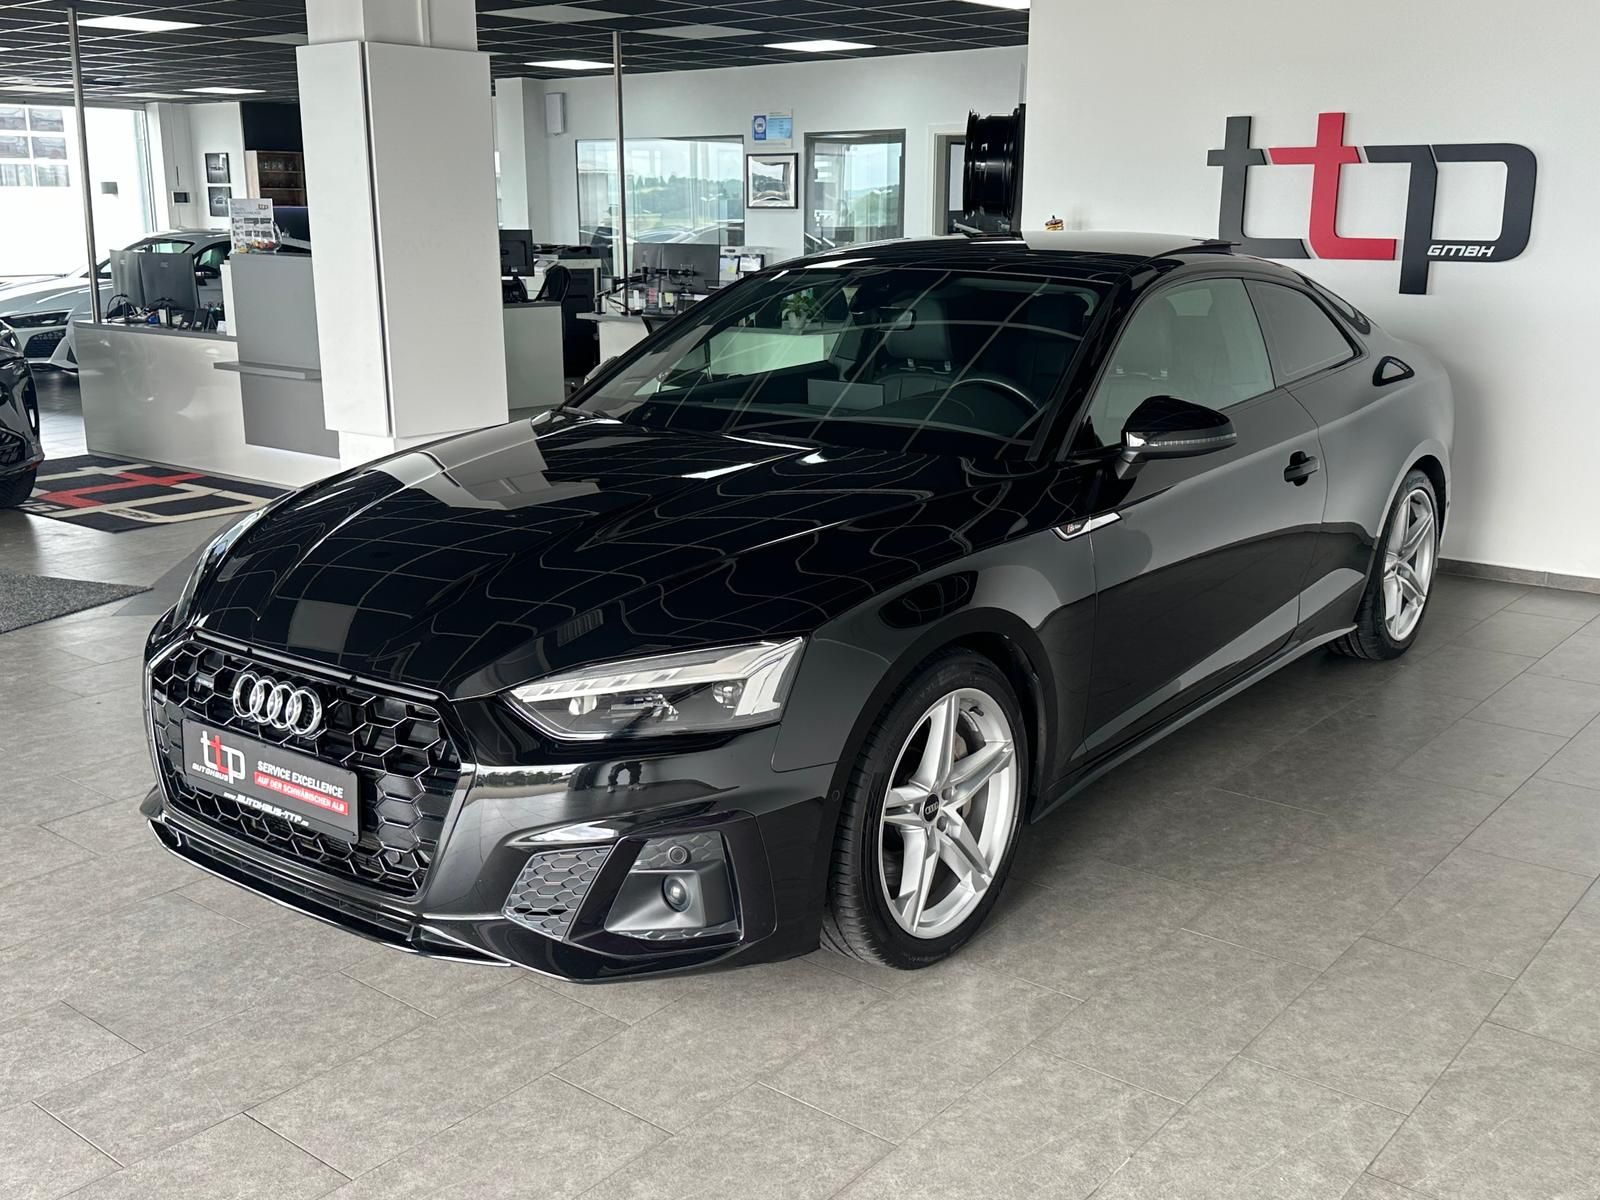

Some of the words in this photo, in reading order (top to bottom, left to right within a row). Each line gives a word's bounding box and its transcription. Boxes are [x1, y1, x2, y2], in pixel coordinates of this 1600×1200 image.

[1207, 112, 1537, 295] ttp
[200, 731, 245, 784] ttp
[257, 760, 291, 780] SERVICE
[291, 772, 344, 799] EXCELLENCE
[258, 775, 270, 786] AUF
[270, 779, 282, 790] DER
[331, 801, 345, 813] ALB
